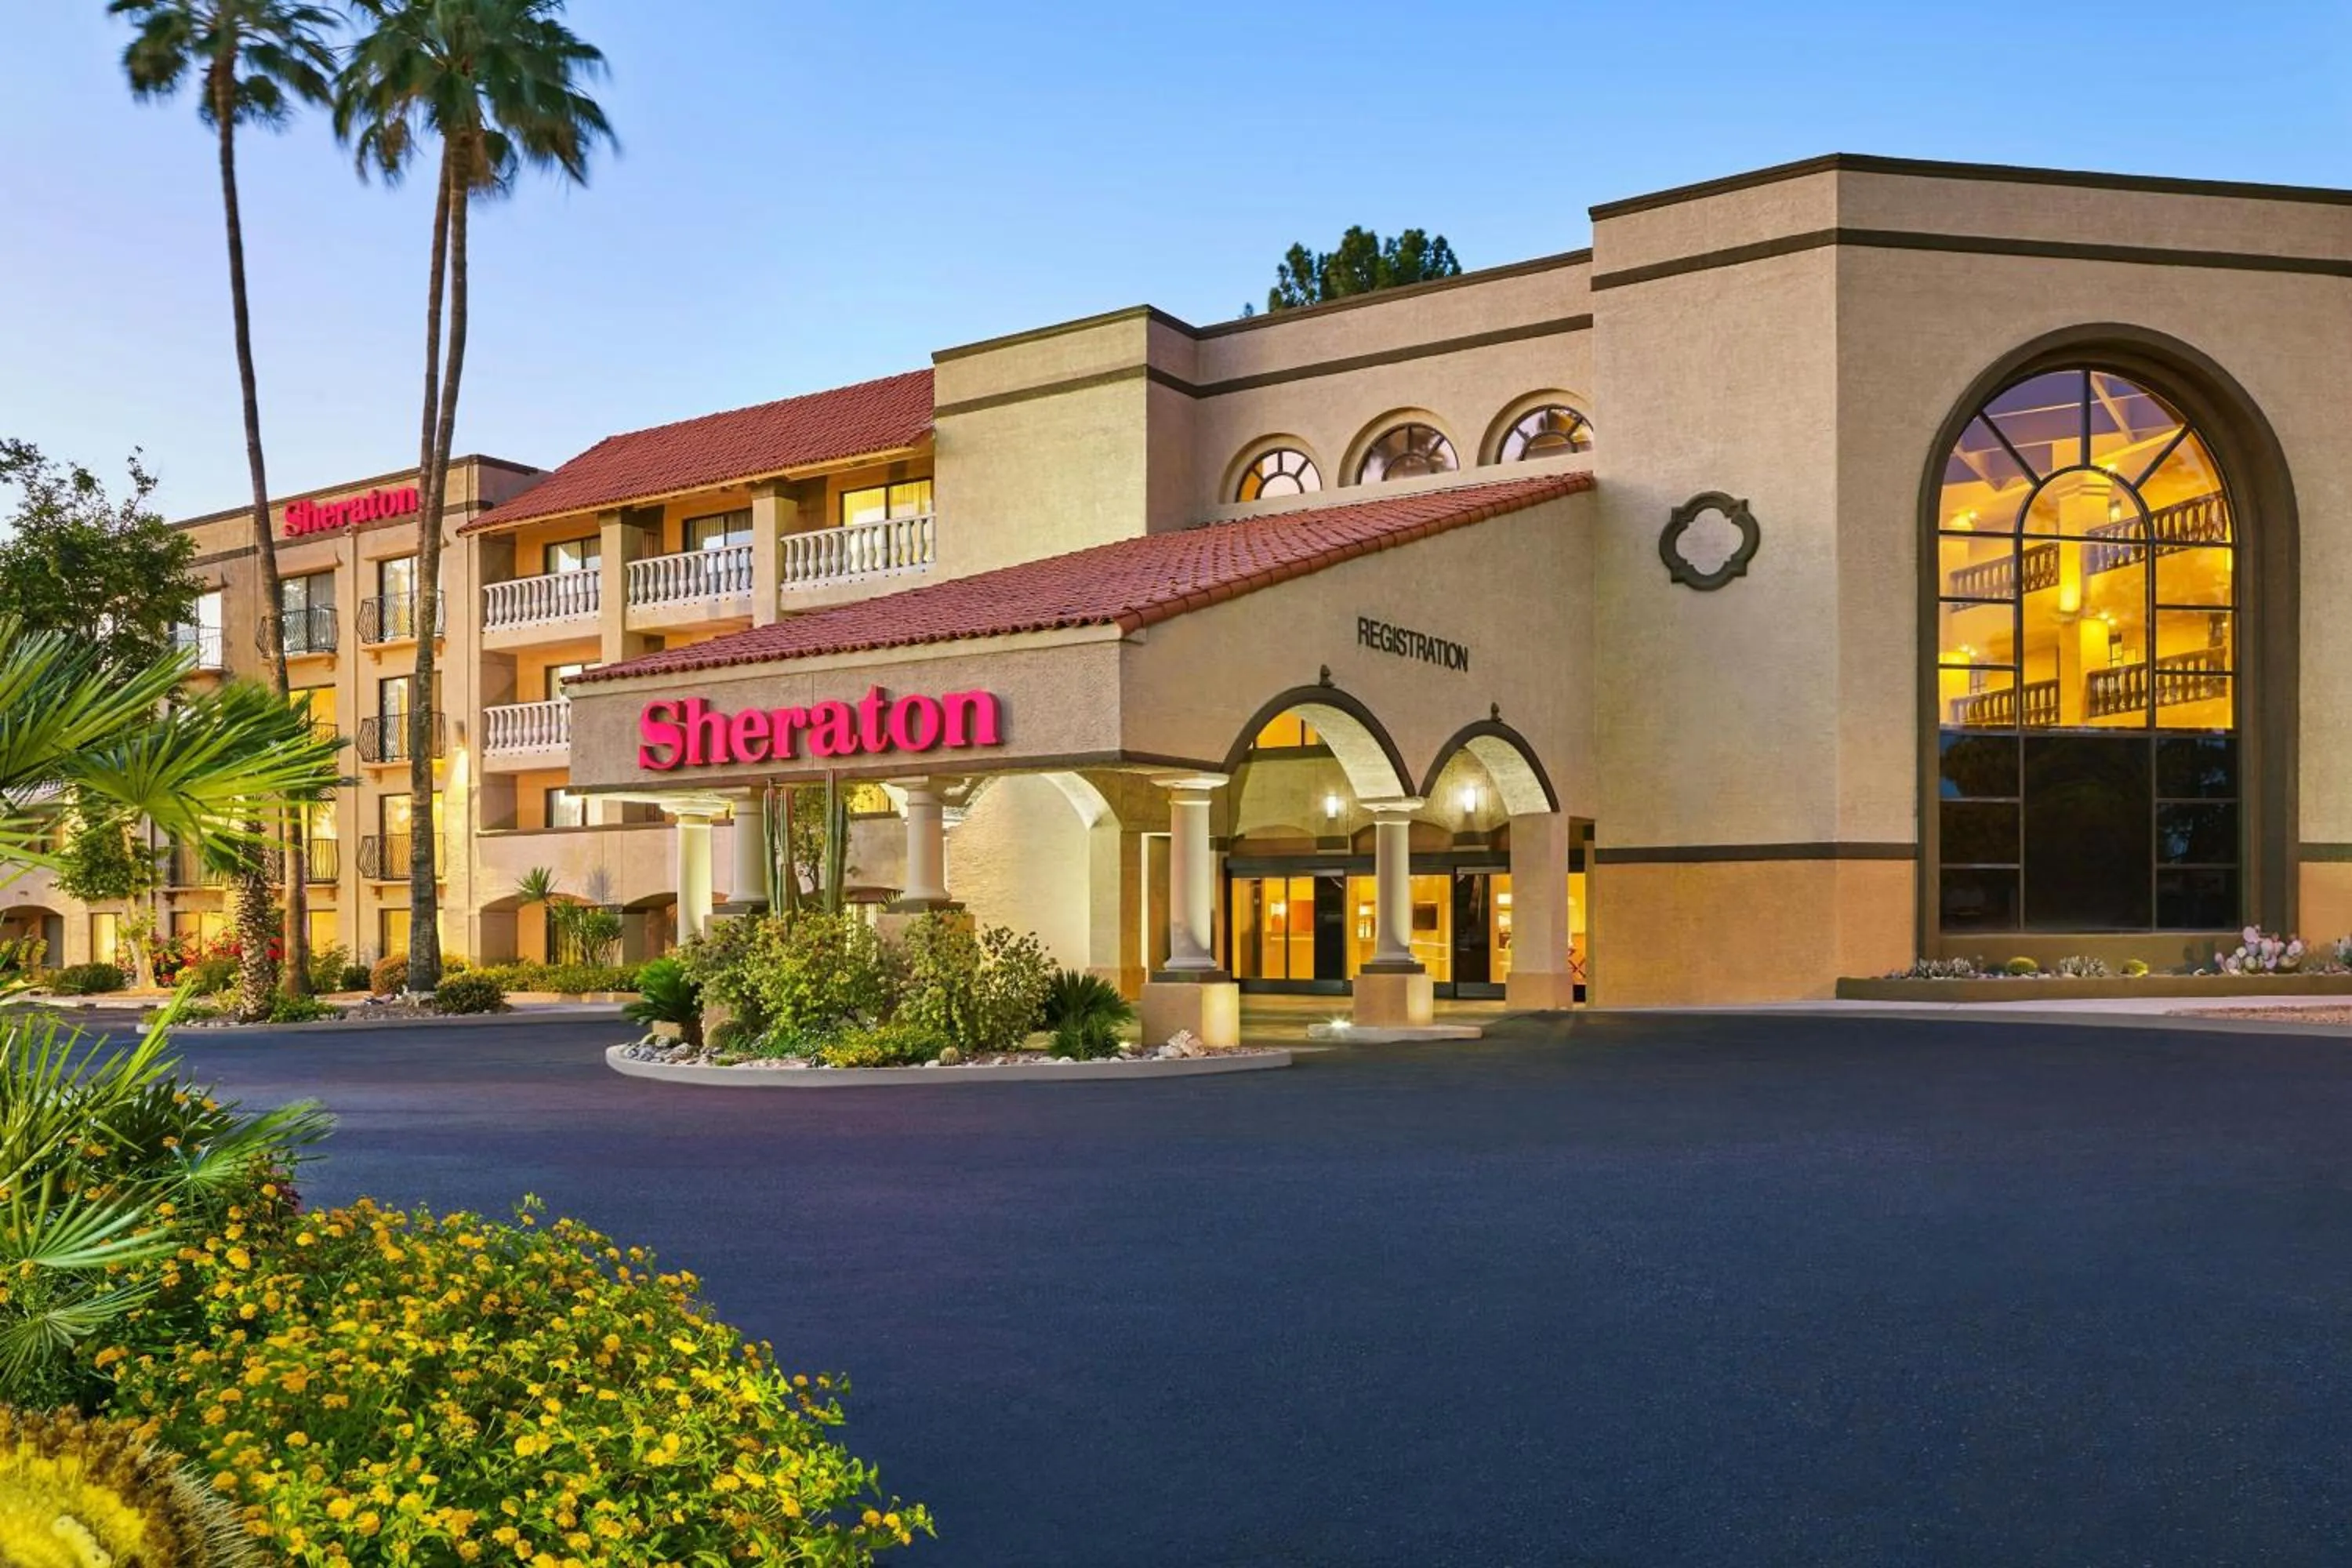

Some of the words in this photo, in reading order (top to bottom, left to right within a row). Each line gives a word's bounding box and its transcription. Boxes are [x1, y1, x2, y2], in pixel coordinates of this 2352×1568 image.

[285, 487, 419, 536] Sheraton
[1358, 616, 1468, 672] REGISTRATION
[638, 684, 1001, 771] Sheraton
